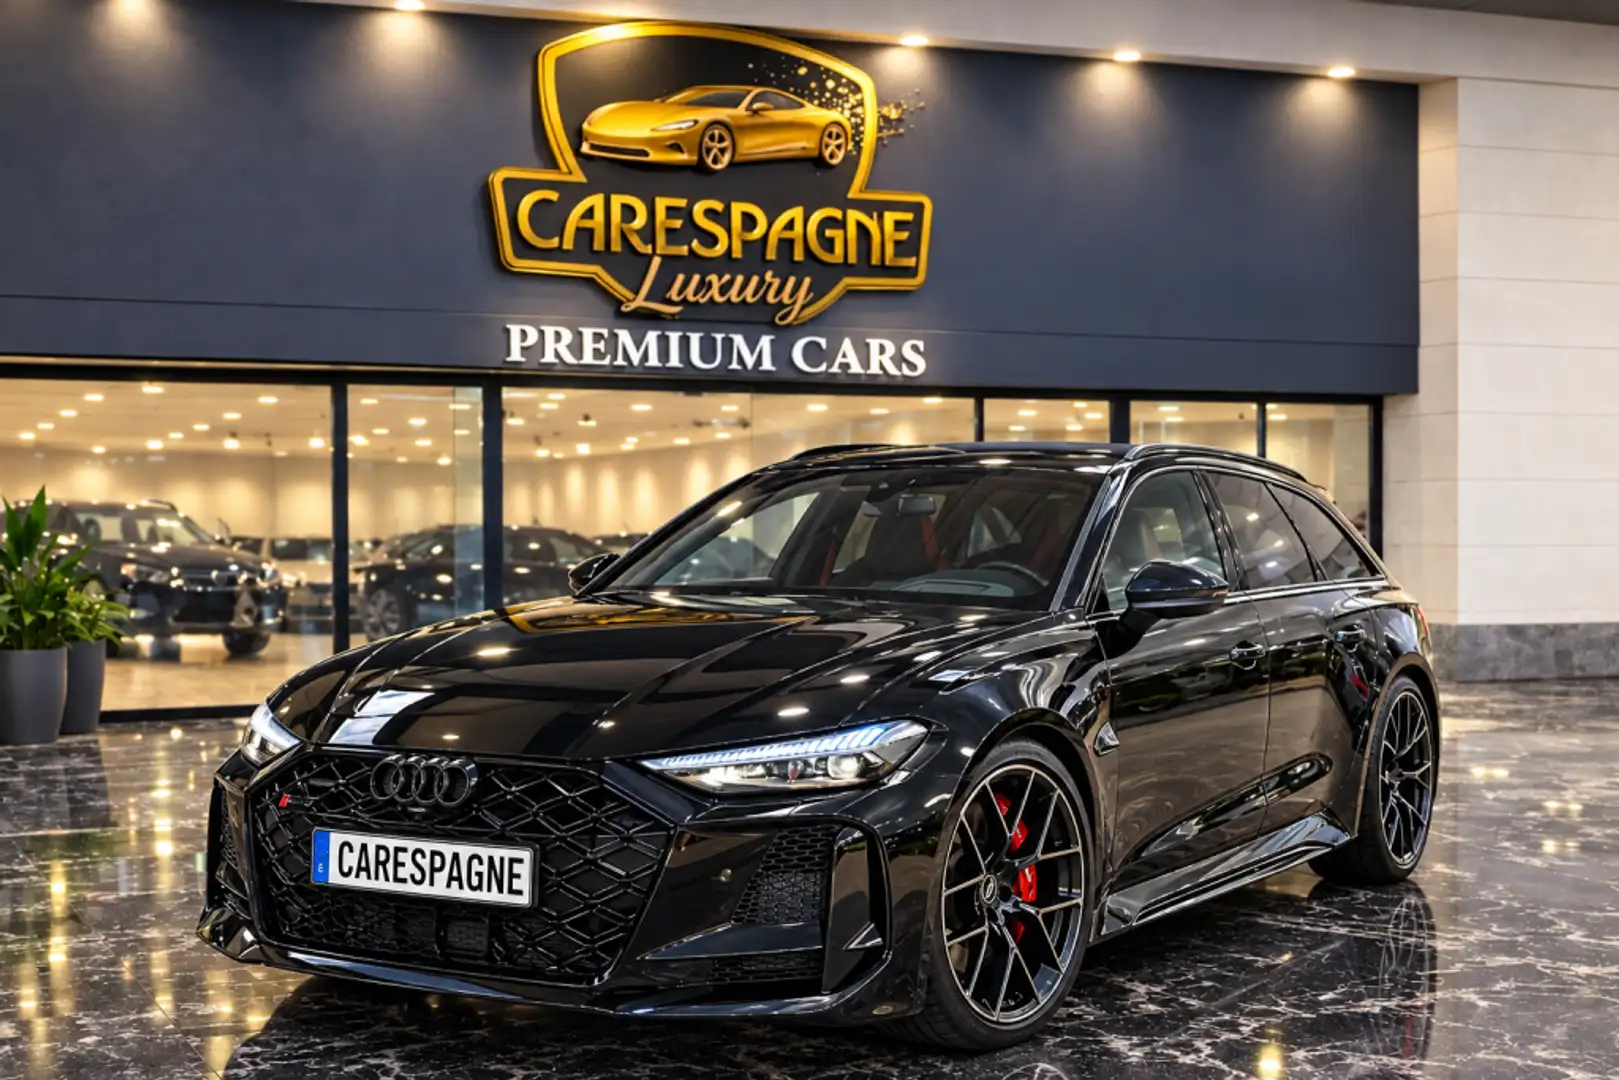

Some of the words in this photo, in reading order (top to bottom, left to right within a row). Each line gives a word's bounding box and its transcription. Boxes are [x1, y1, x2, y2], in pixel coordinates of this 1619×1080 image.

[517, 189, 918, 267] CARESPAGNE
[621, 255, 814, 326] Luxury
[505, 323, 777, 372] PREMIUM
[791, 334, 927, 378] CARS
[337, 840, 525, 896] CARESPAGNE
